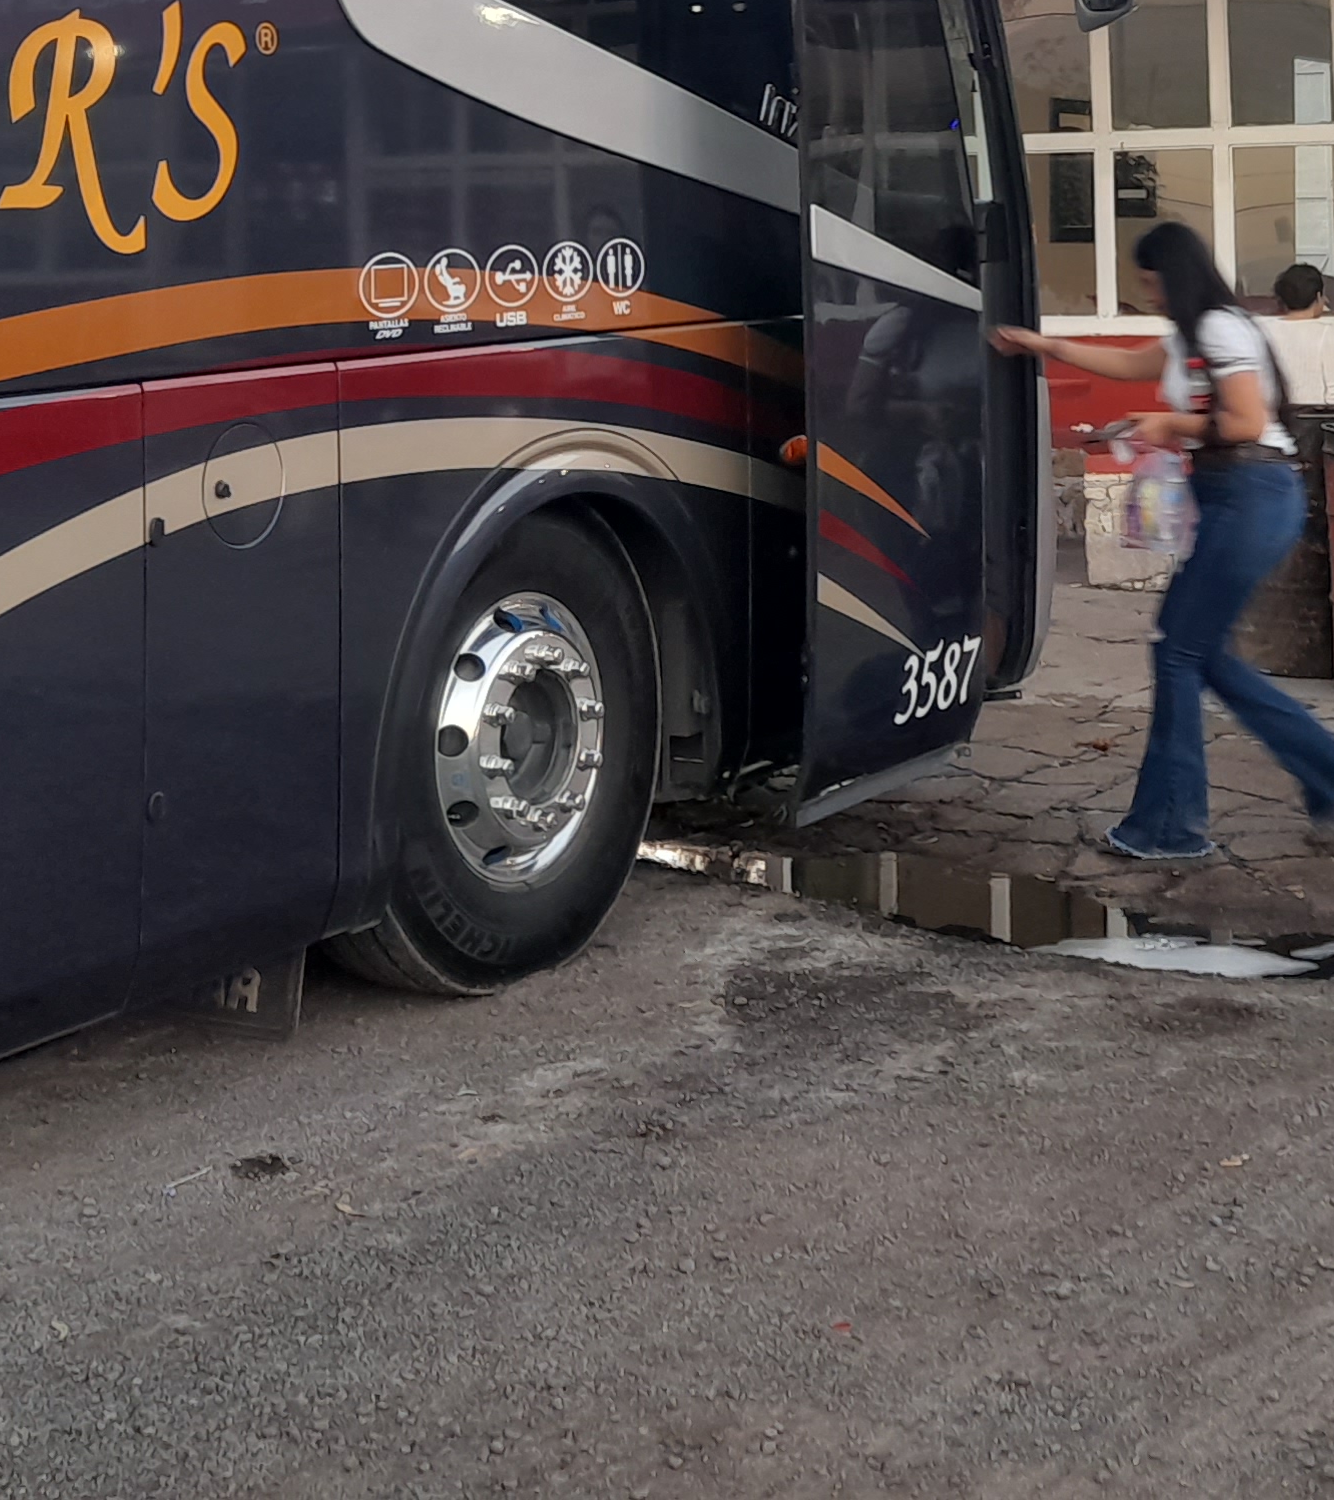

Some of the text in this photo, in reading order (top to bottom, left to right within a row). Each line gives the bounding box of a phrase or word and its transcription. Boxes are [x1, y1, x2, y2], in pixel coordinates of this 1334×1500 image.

[612, 300, 632, 316] WC
[368, 318, 410, 331] PANTALLAS
[495, 310, 528, 328] USB
[374, 328, 404, 340] DVD
[892, 633, 983, 726] 3587
